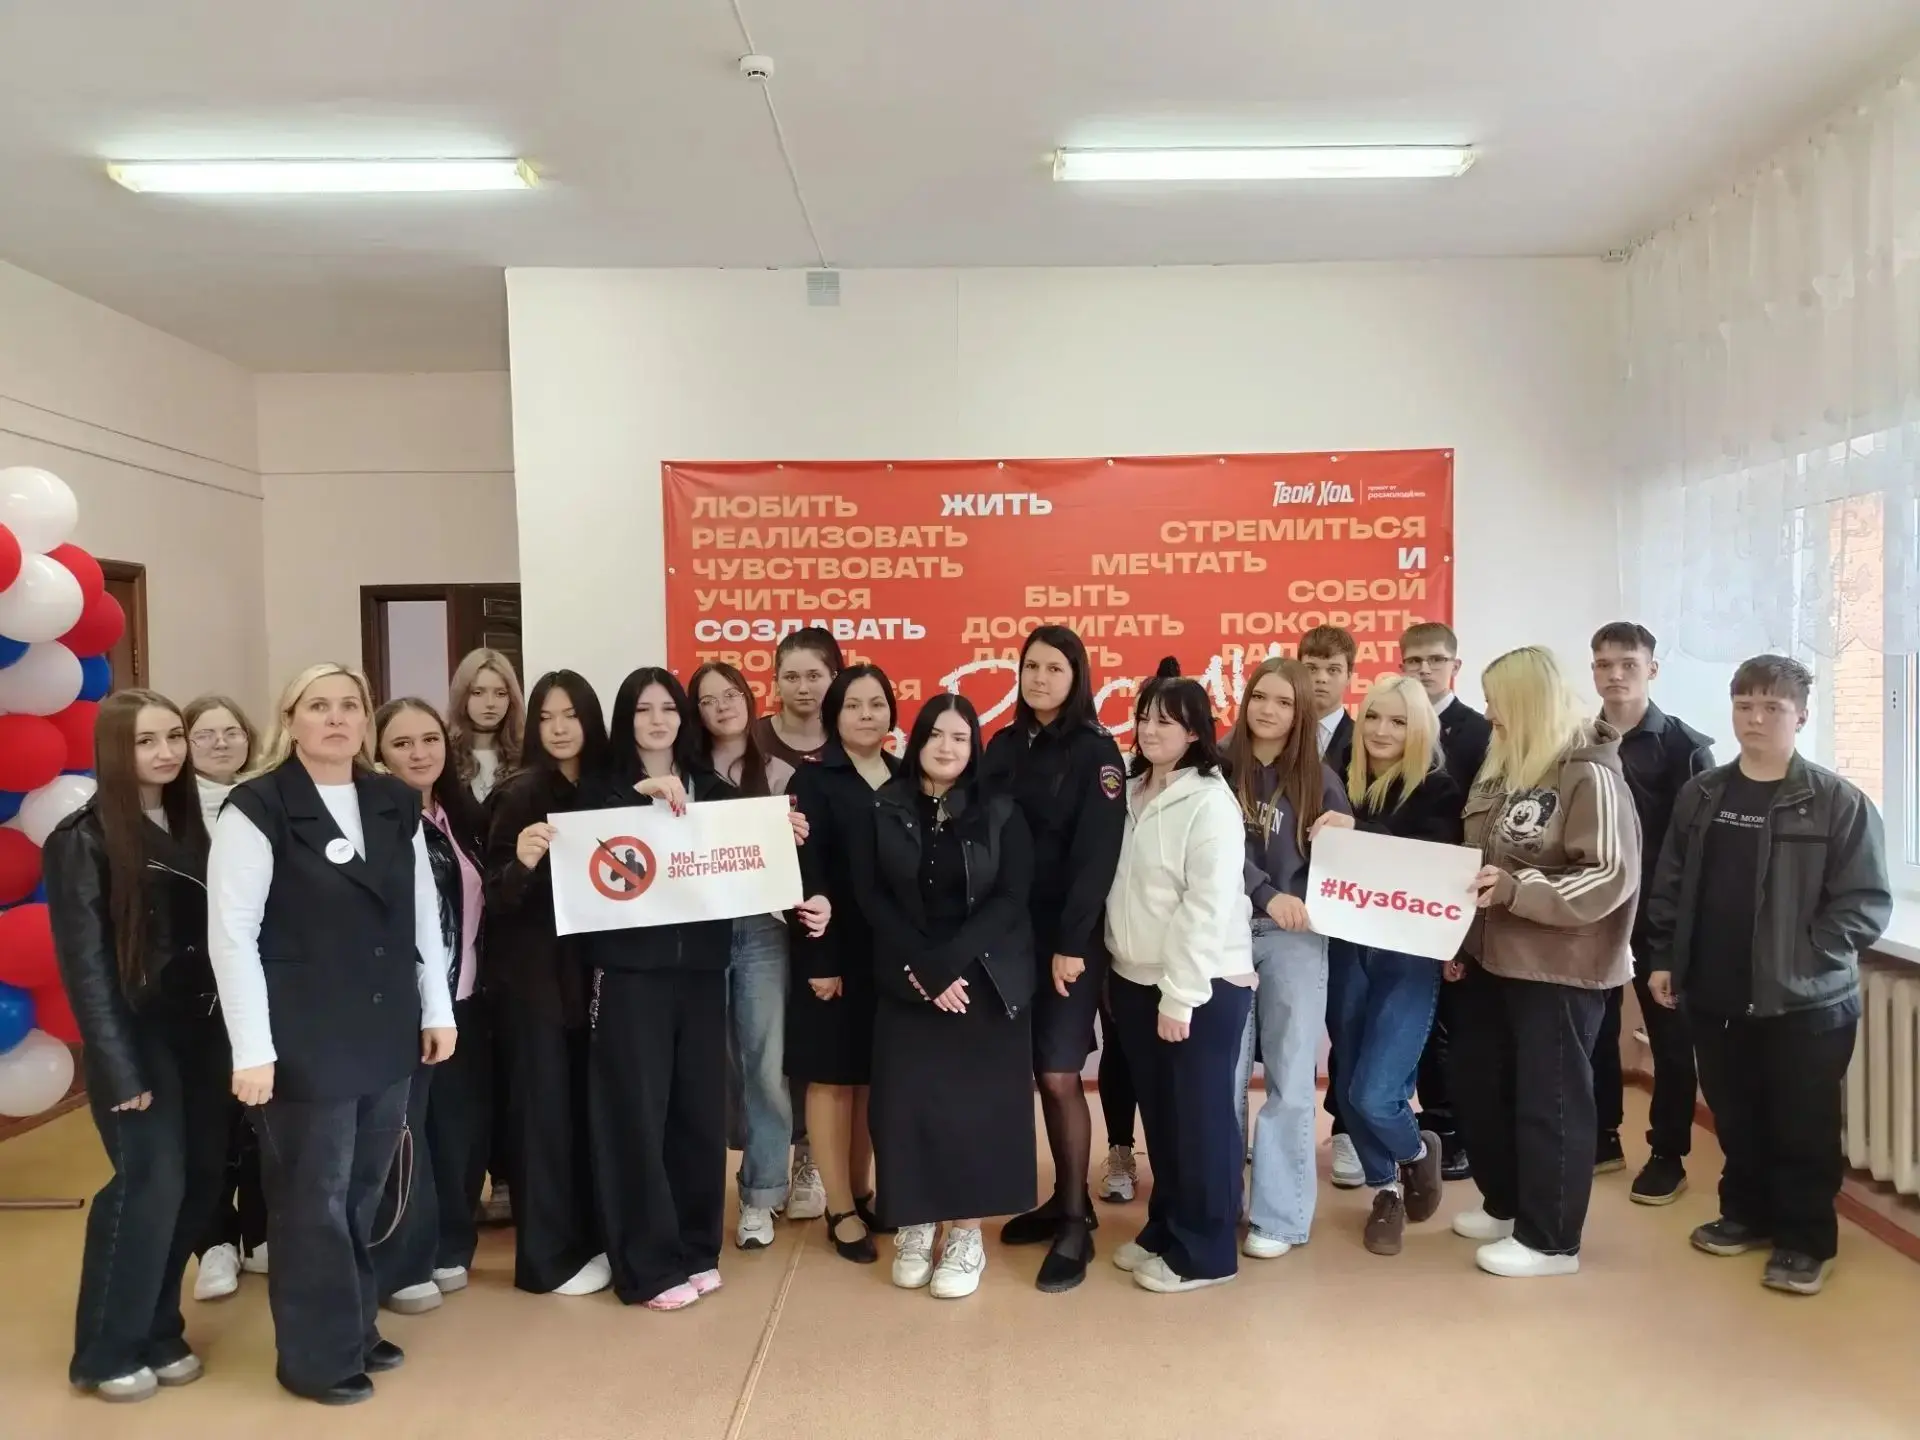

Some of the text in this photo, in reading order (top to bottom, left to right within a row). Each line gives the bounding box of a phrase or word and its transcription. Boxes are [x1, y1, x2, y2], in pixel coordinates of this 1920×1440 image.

[691, 495, 858, 519] ЛЮБИТЬ
[940, 492, 1053, 517] ЖИТЬ
[692, 525, 969, 549] РЕАЛИЗОВАТЬ
[1160, 516, 1426, 544] СТРЕМИТЬСЯ
[693, 556, 964, 580] ЧУВСТВОВАТЬ
[1091, 550, 1268, 576] МЕЧТАТЬ
[1398, 546, 1426, 570] И
[694, 587, 871, 611] УЧИТЬСЯ
[1025, 584, 1130, 608] БЫТЬ
[1287, 572, 1426, 603] СОБОЙ
[671, 851, 695, 865] МЫ
[711, 845, 760, 861] ПРОТИВ
[667, 857, 766, 878] ЭКСТРЕМИЗМА
[1320, 878, 1462, 921] #Кузбасс
